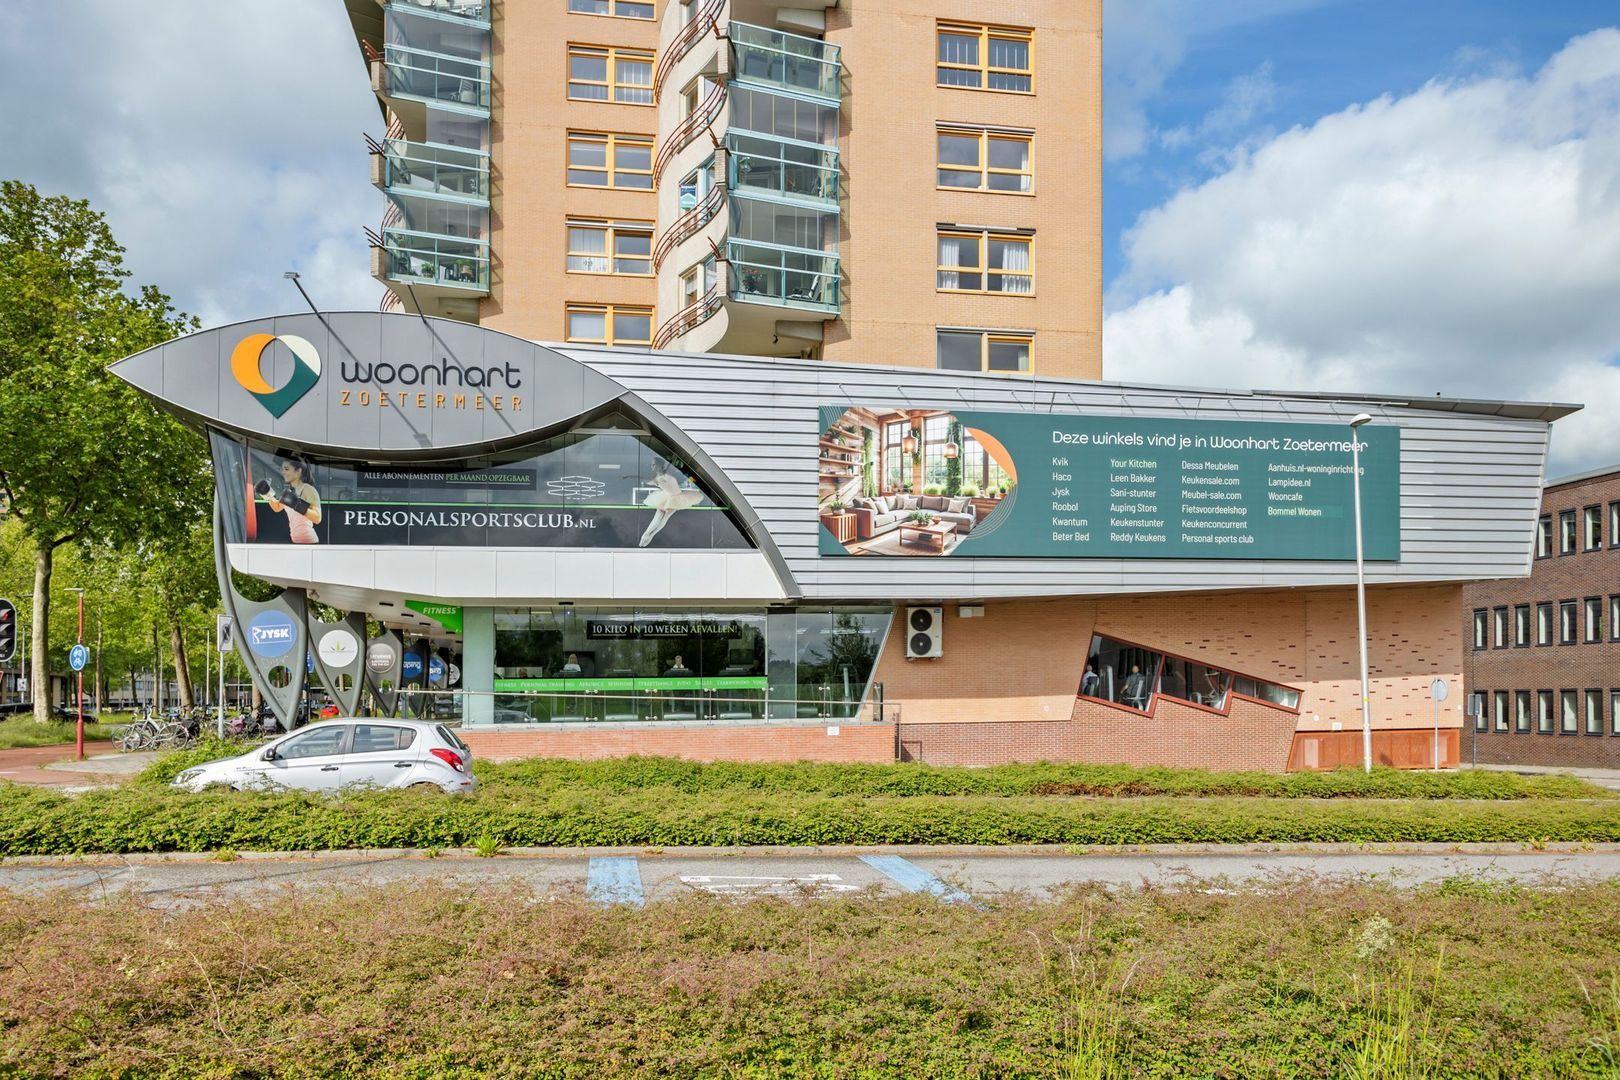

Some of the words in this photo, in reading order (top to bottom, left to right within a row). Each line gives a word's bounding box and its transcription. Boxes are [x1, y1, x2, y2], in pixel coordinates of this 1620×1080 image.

[341, 358, 521, 388] woonhart
[340, 391, 522, 411] ZOETERMEER
[1052, 431, 1089, 444] Deze
[1092, 432, 1144, 445] winkels
[1147, 434, 1176, 447] vind
[1178, 435, 1192, 450] je
[1195, 437, 1206, 448] in
[1210, 436, 1280, 450] Woonhart
[1283, 438, 1368, 452] Zoetermeer
[1052, 457, 1068, 466] Kvik
[1110, 459, 1127, 468] Your
[1129, 459, 1157, 468] Kitchen
[1182, 461, 1203, 470] Dessa
[1204, 461, 1238, 470] Meubelen
[1052, 473, 1072, 481] Haco
[1110, 474, 1129, 482] Leen
[1130, 474, 1156, 483] Bakker
[1182, 476, 1240, 485] Keukensale.com
[1268, 478, 1311, 488] Lampidee.nl
[1052, 488, 1070, 498] Jysk
[1110, 489, 1156, 498] Sani-stunter
[1182, 490, 1242, 500] Meubel-sale.com
[1268, 492, 1303, 501] Wooncafe
[1110, 503, 1136, 513] Auping
[1137, 504, 1157, 512] Store
[1182, 505, 1247, 516] Fietsvoordeelshop
[1268, 507, 1296, 516] Bommel
[1298, 507, 1322, 516] Wonen
[344, 510, 596, 529] PERSONALSPORTSCLUB.NL
[1052, 518, 1088, 526] Kwantum
[1110, 518, 1164, 527] Keukenstunter
[1182, 520, 1247, 529] Keukenconcurrent
[1052, 532, 1073, 541] Beter
[1074, 533, 1089, 542] Bed
[1110, 533, 1133, 544] Reddy
[1135, 533, 1166, 542] Keukens
[1182, 534, 1213, 543] Personal
[1214, 535, 1237, 544] sports
[261, 628, 289, 639] JYSK
[592, 625, 602, 633] 10
[605, 625, 627, 633] KILO
[644, 625, 654, 633] 10
[655, 625, 688, 633] WEKEN
